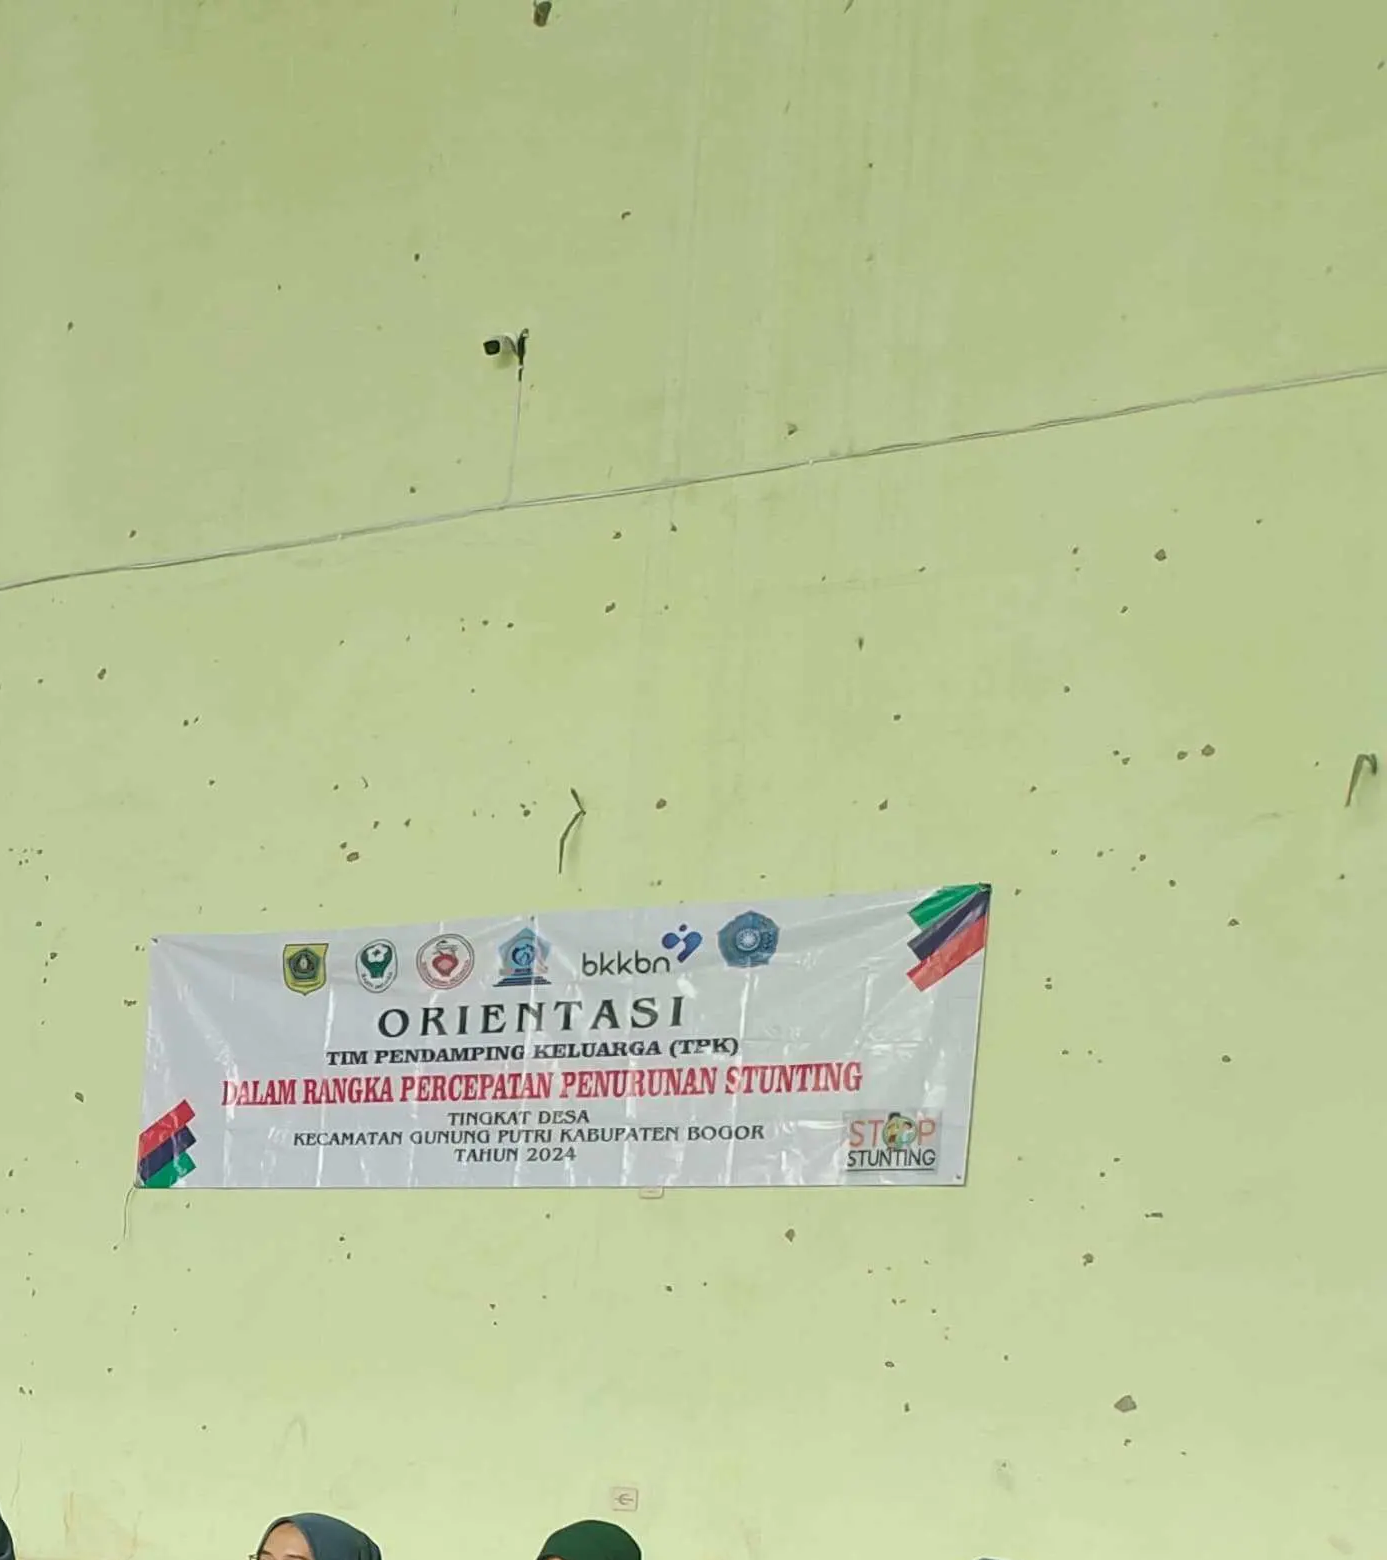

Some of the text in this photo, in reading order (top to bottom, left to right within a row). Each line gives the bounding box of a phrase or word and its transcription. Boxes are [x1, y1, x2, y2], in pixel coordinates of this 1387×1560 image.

[582, 949, 670, 976] bkkbn
[378, 996, 685, 1038] ORIENTASI
[327, 1037, 739, 1066] TIM PENDAMPING KELUARGA (TPK)
[221, 1061, 863, 1106] DALAM RANGKA PERCEPATAN PENURUNAN STUNTING
[447, 1109, 590, 1127] TINGKAT DESA
[848, 1115, 936, 1148] STOP
[293, 1125, 765, 1147] KECAMATAN GUNUNG PUTRI KABUPATEN BOGOR
[454, 1146, 577, 1163] TAHUN 2024
[847, 1149, 937, 1168] STUNTING
